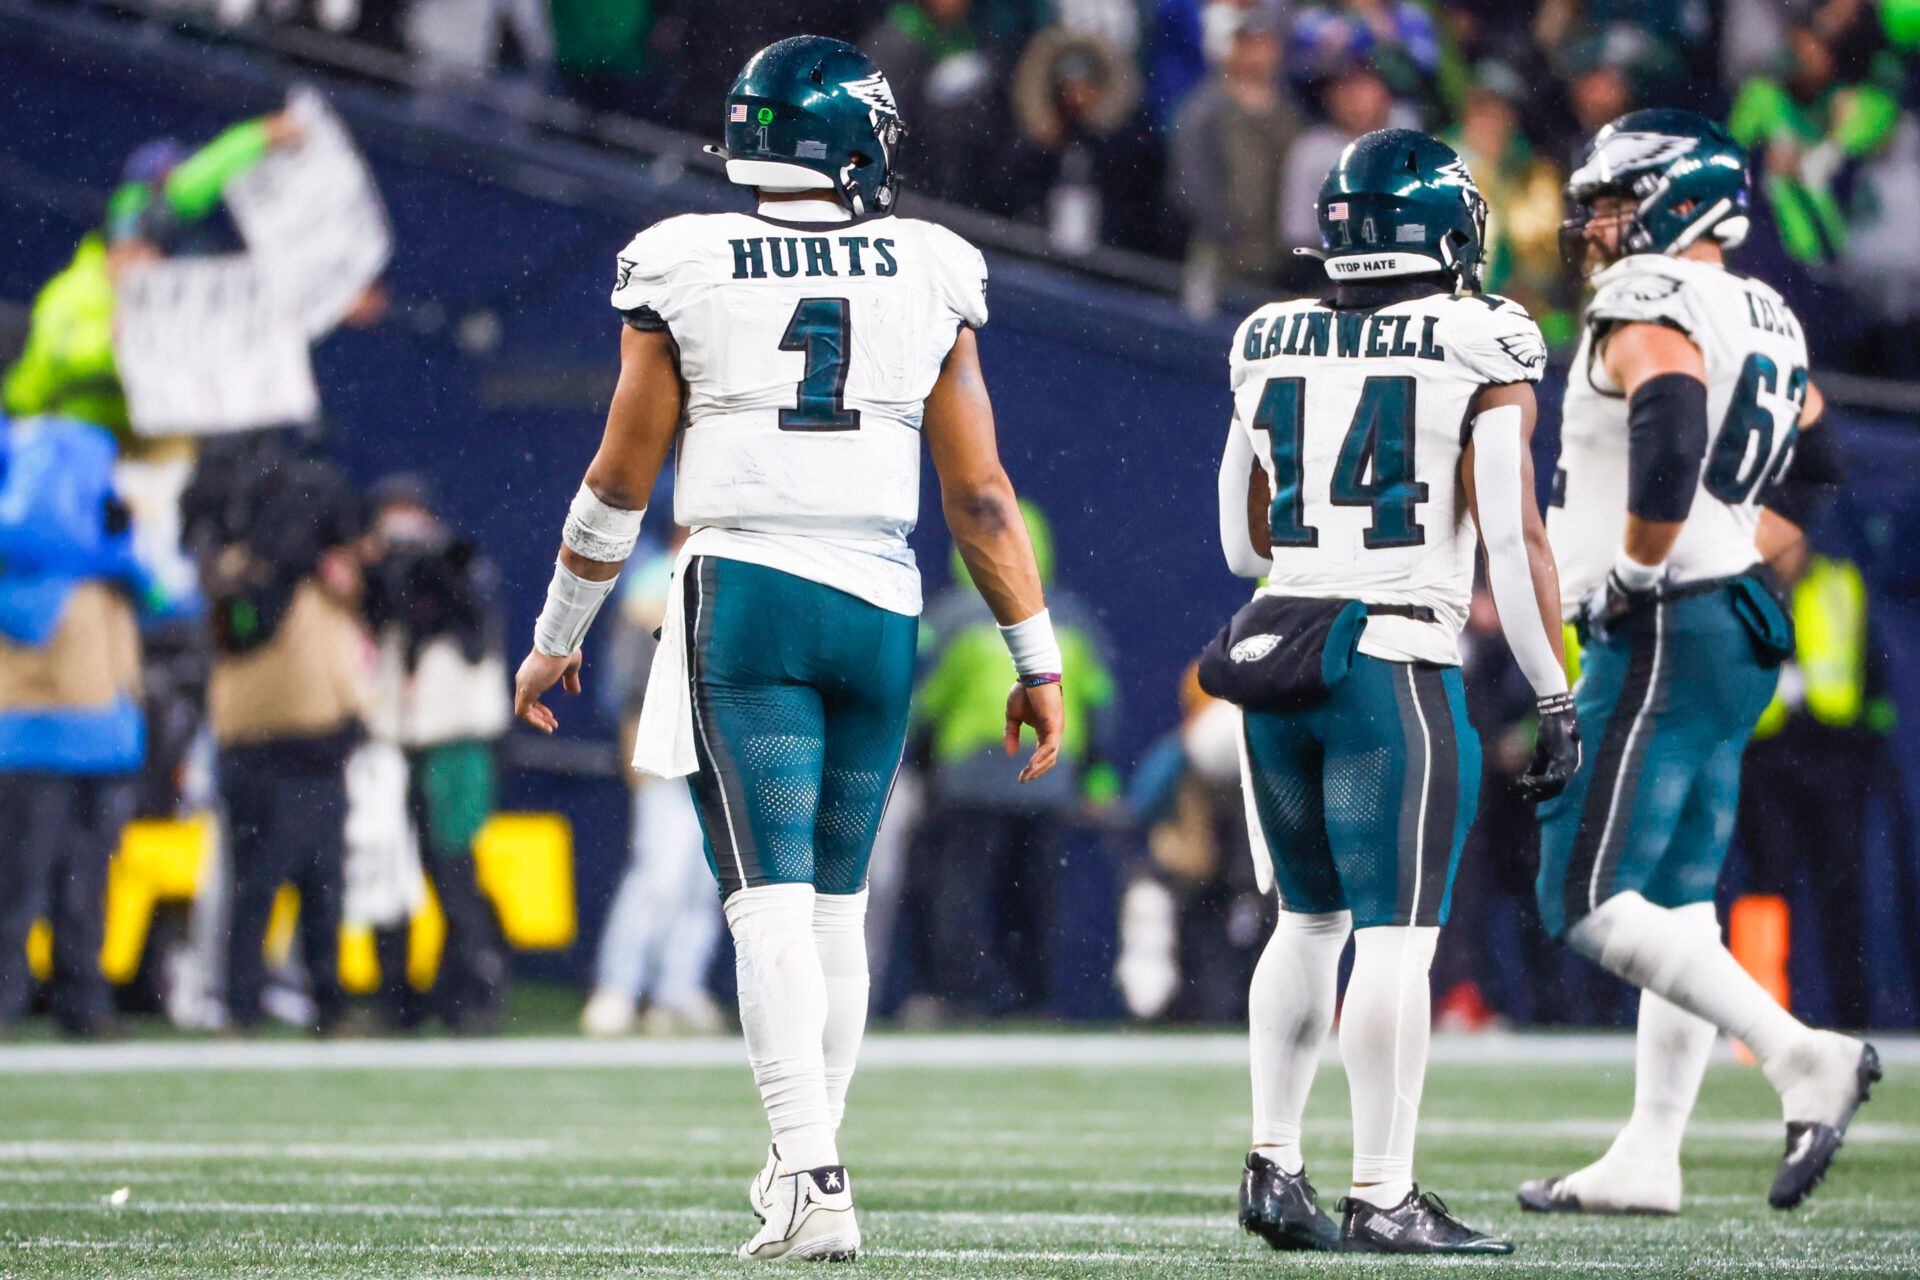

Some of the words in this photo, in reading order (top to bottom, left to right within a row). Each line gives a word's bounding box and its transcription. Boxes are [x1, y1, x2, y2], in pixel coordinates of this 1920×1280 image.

[755, 125, 770, 151] 1
[728, 237, 898, 279] HURTS
[1334, 262, 1360, 273] STOP
[1363, 260, 1396, 271] HATE
[1243, 311, 1445, 361] GAINWELL
[778, 297, 861, 431] 1
[1253, 376, 1429, 549] 14
